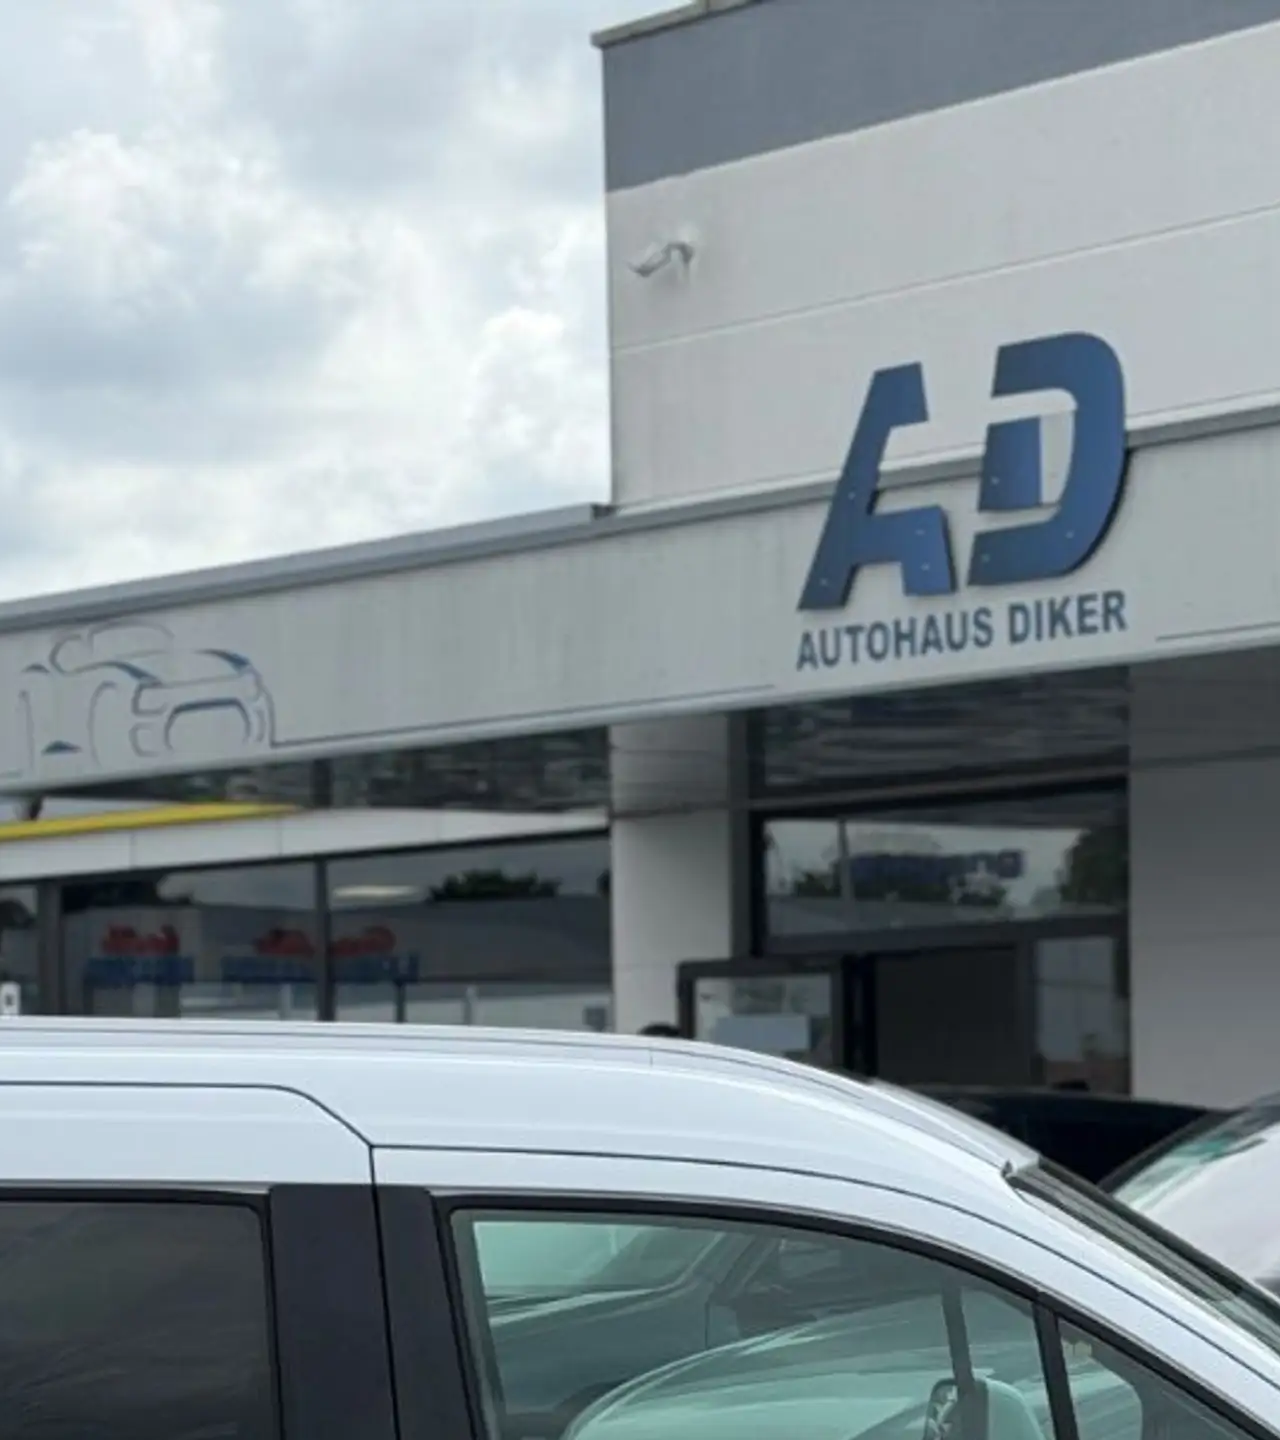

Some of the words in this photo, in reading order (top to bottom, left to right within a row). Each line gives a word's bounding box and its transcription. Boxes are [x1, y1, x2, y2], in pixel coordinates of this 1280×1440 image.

[796, 330, 1128, 612] AD
[795, 605, 995, 672] AUTOHAUS
[1007, 589, 1128, 645] DIKER
